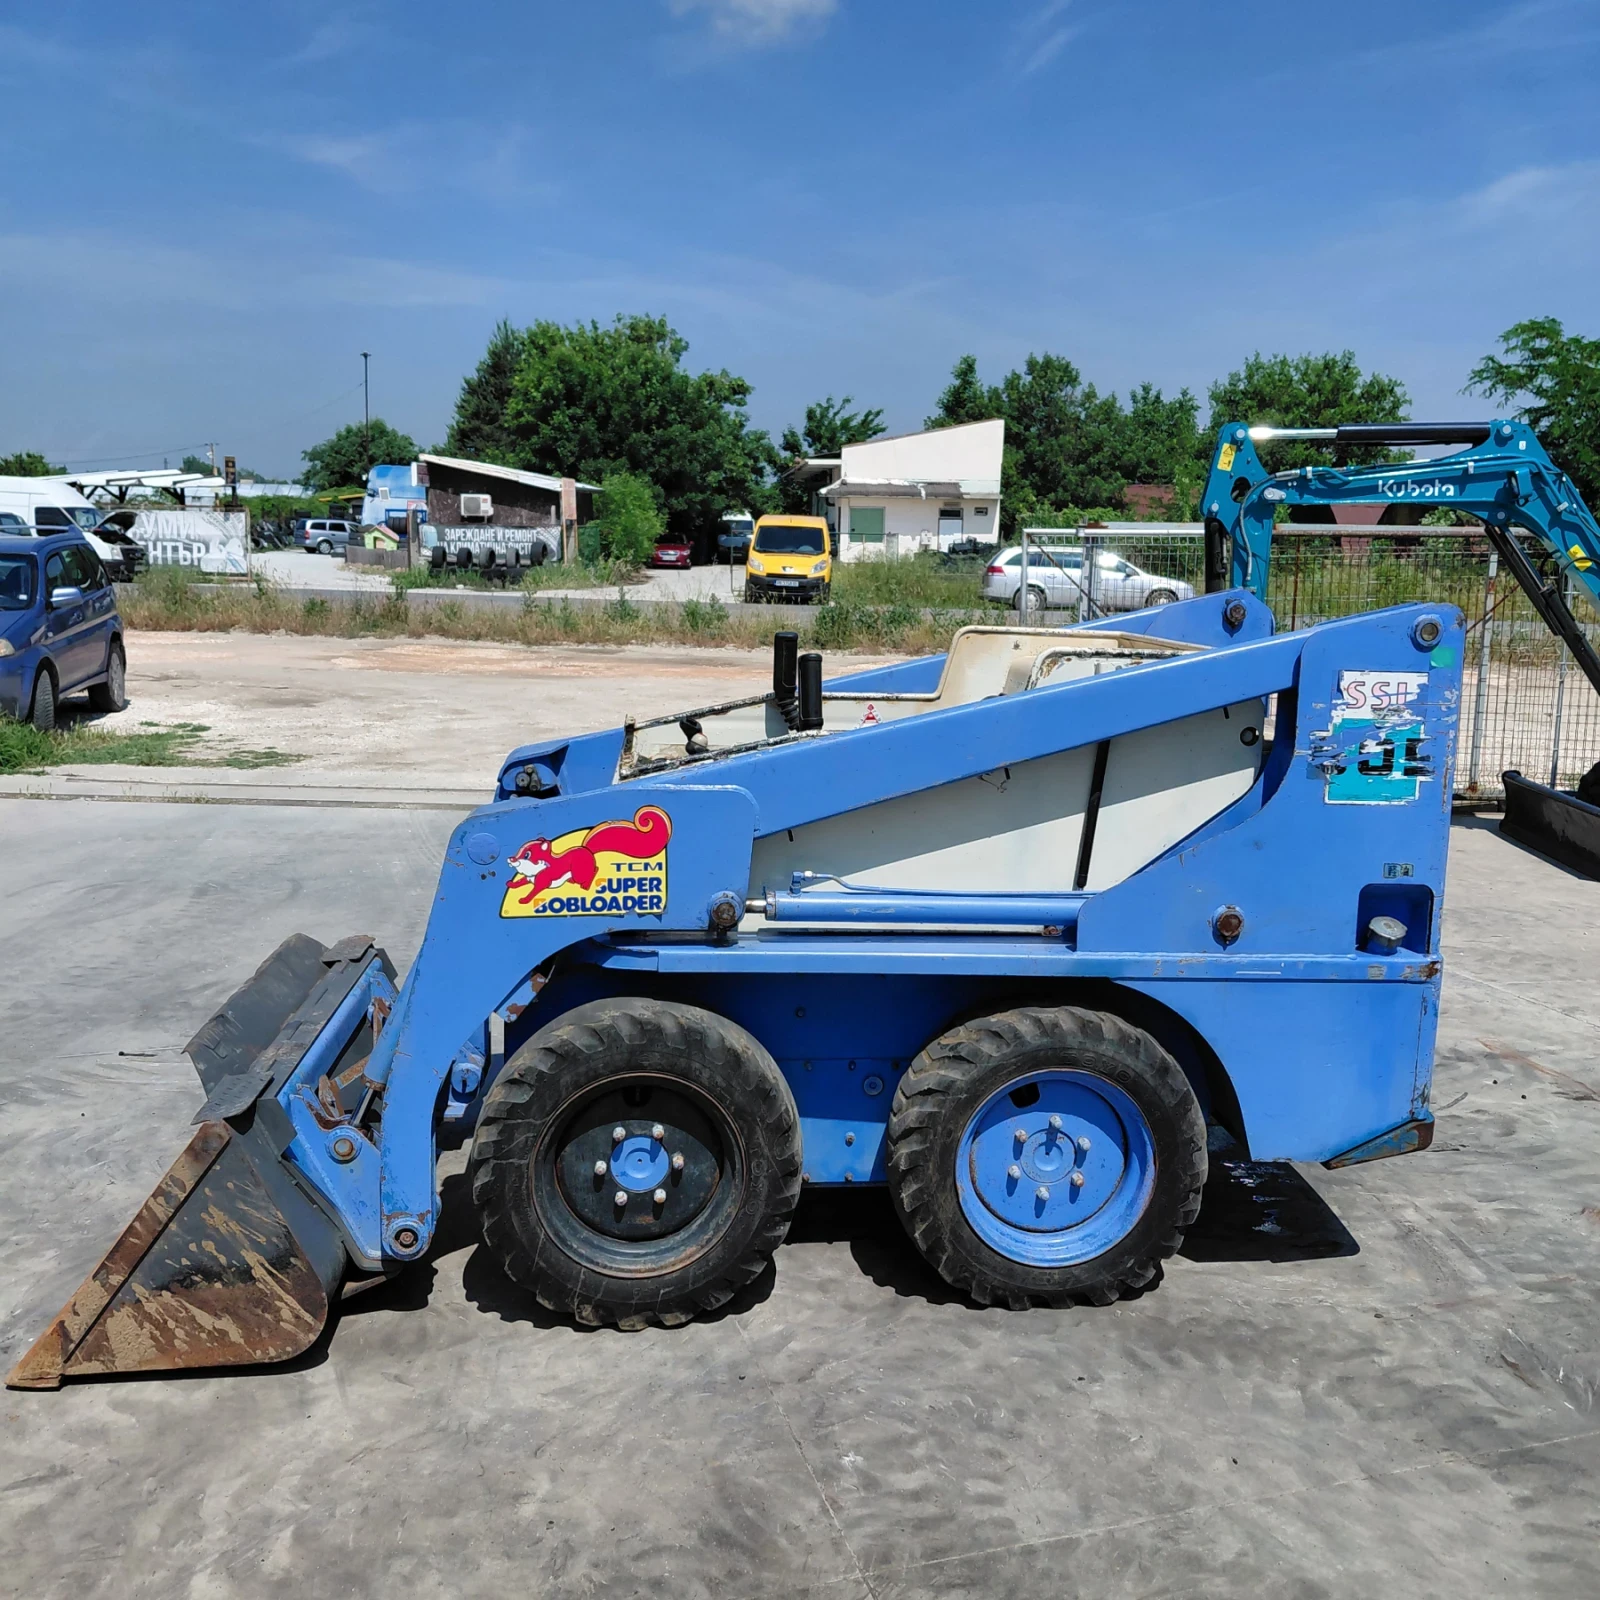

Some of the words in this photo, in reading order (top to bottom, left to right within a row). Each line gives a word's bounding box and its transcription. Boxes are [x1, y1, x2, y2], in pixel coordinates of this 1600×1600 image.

[1378, 479, 1455, 497] Kubota
[141, 511, 197, 540] УМИ
[444, 528, 496, 541] ЗАРЕЖДАНЕ
[497, 529, 504, 541] И
[505, 529, 537, 543] РЕМОНТ
[139, 541, 206, 566] НТЪР
[610, 862, 663, 872] TCM
[595, 877, 662, 894] SUPER
[533, 895, 662, 914] BOBLOADER
